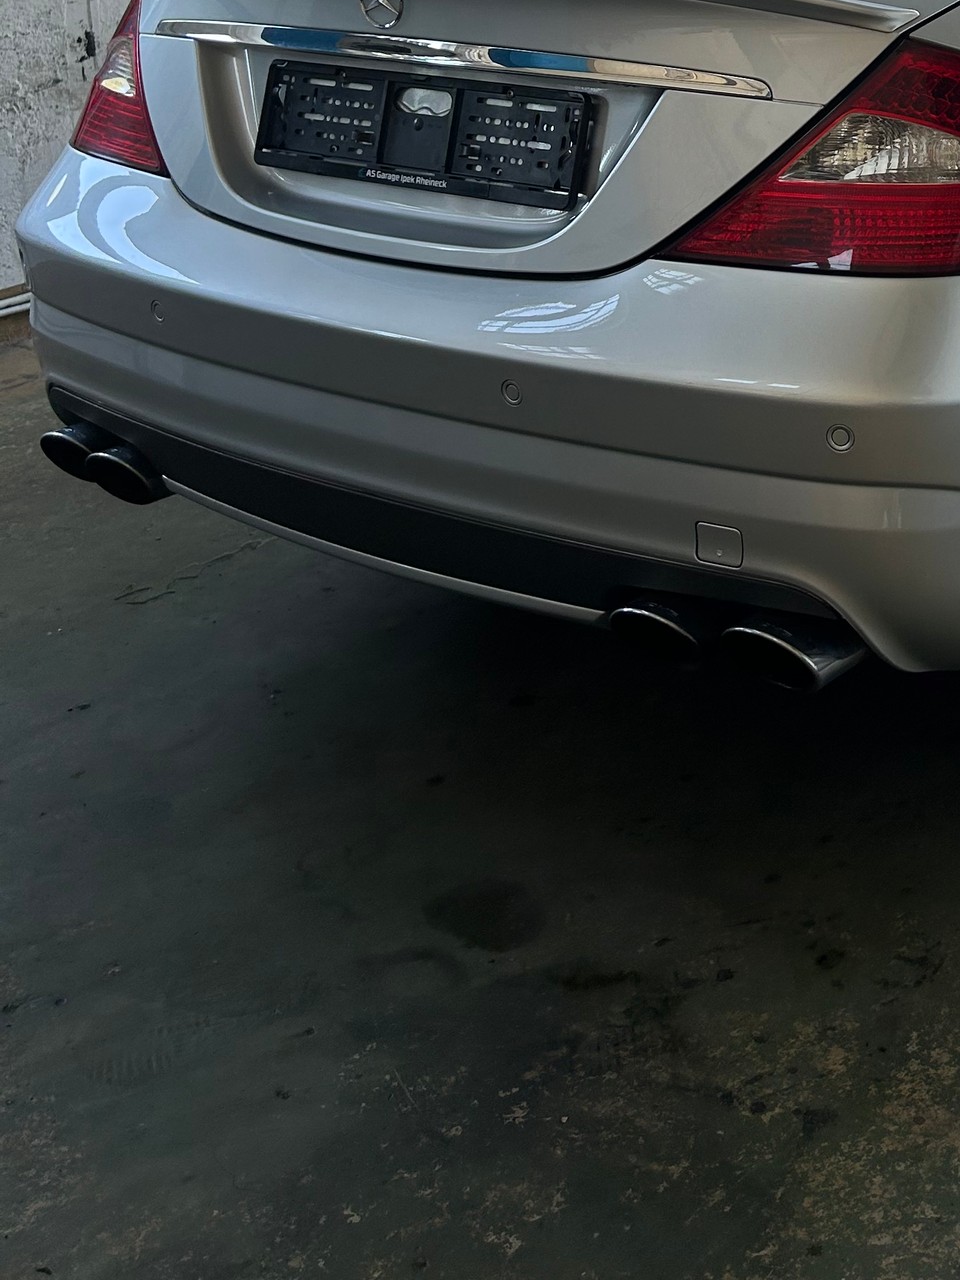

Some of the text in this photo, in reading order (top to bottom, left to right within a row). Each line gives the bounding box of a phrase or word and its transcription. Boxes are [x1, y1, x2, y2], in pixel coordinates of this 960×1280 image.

[366, 169, 447, 188] AS Garage Ipek Rheineck
